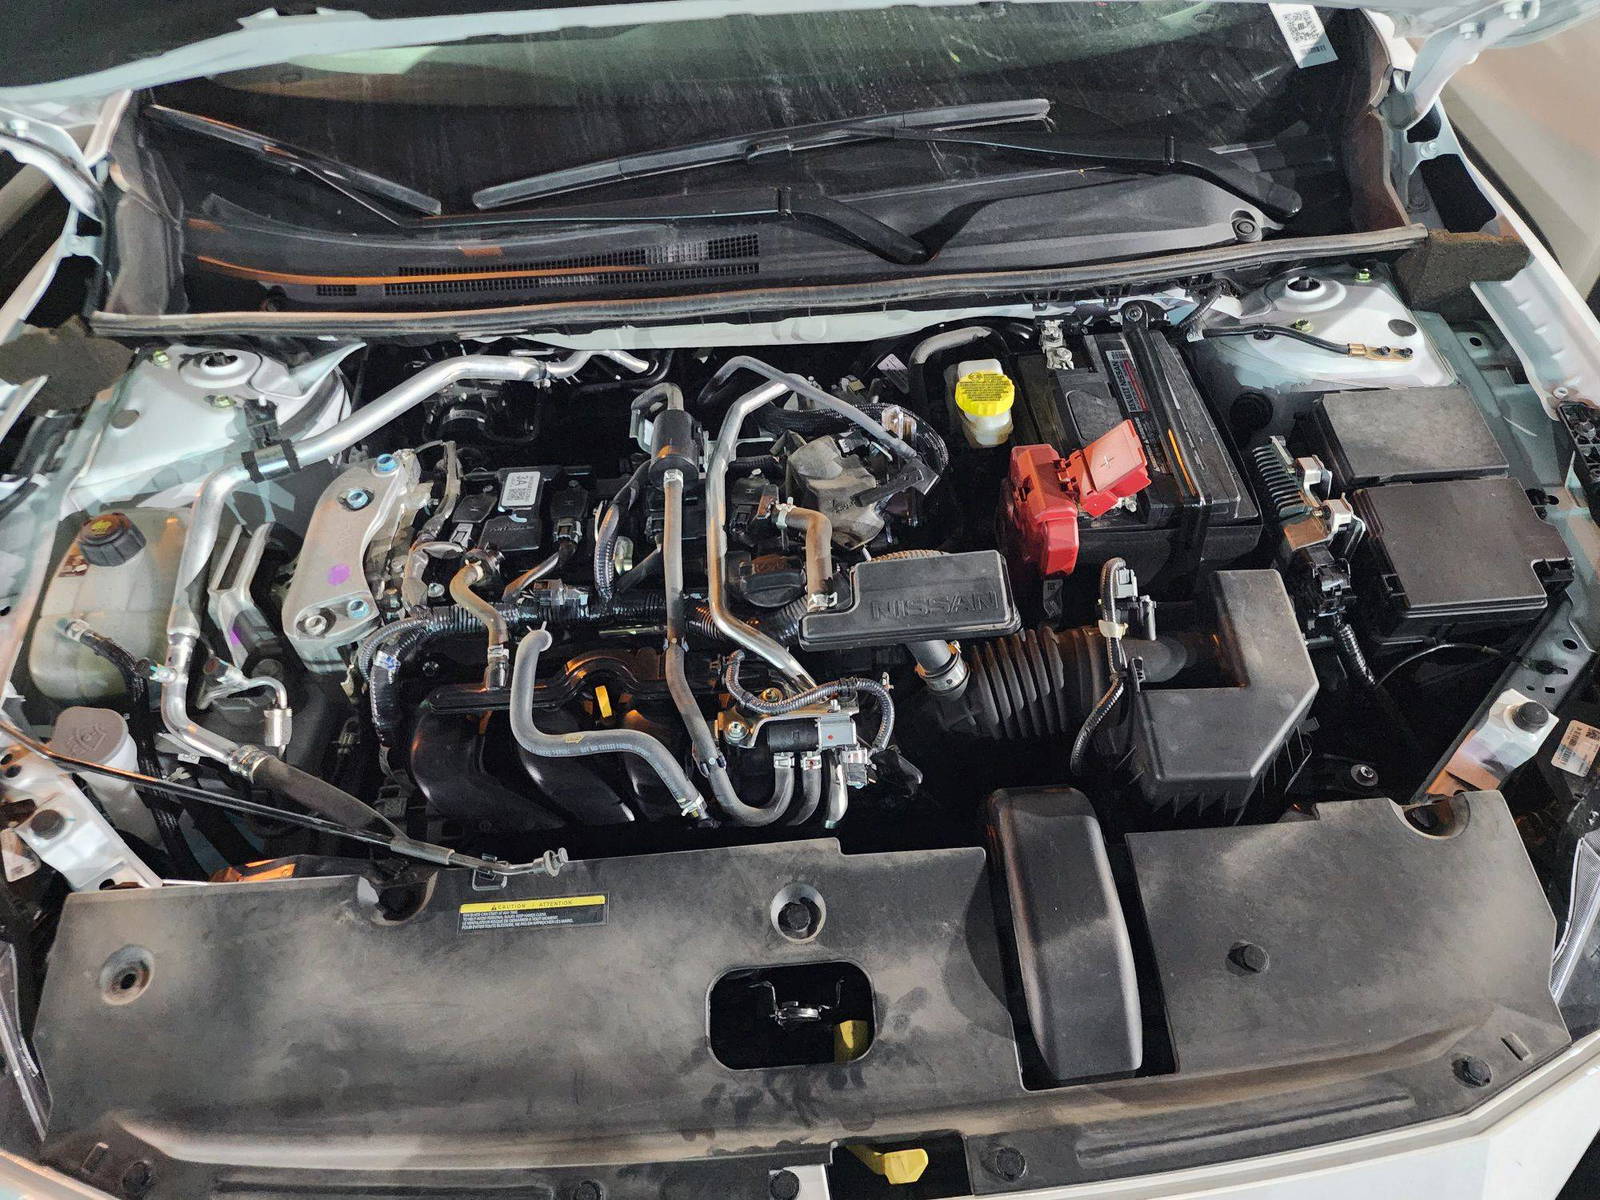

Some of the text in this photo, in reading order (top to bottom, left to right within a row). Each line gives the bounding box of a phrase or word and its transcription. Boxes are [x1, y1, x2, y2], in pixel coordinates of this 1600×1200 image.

[1111, 360, 1127, 386] NISSAN
[871, 590, 999, 619] NISSAN
[497, 903, 527, 911] CAUTION
[538, 899, 573, 908] ATTENTION
